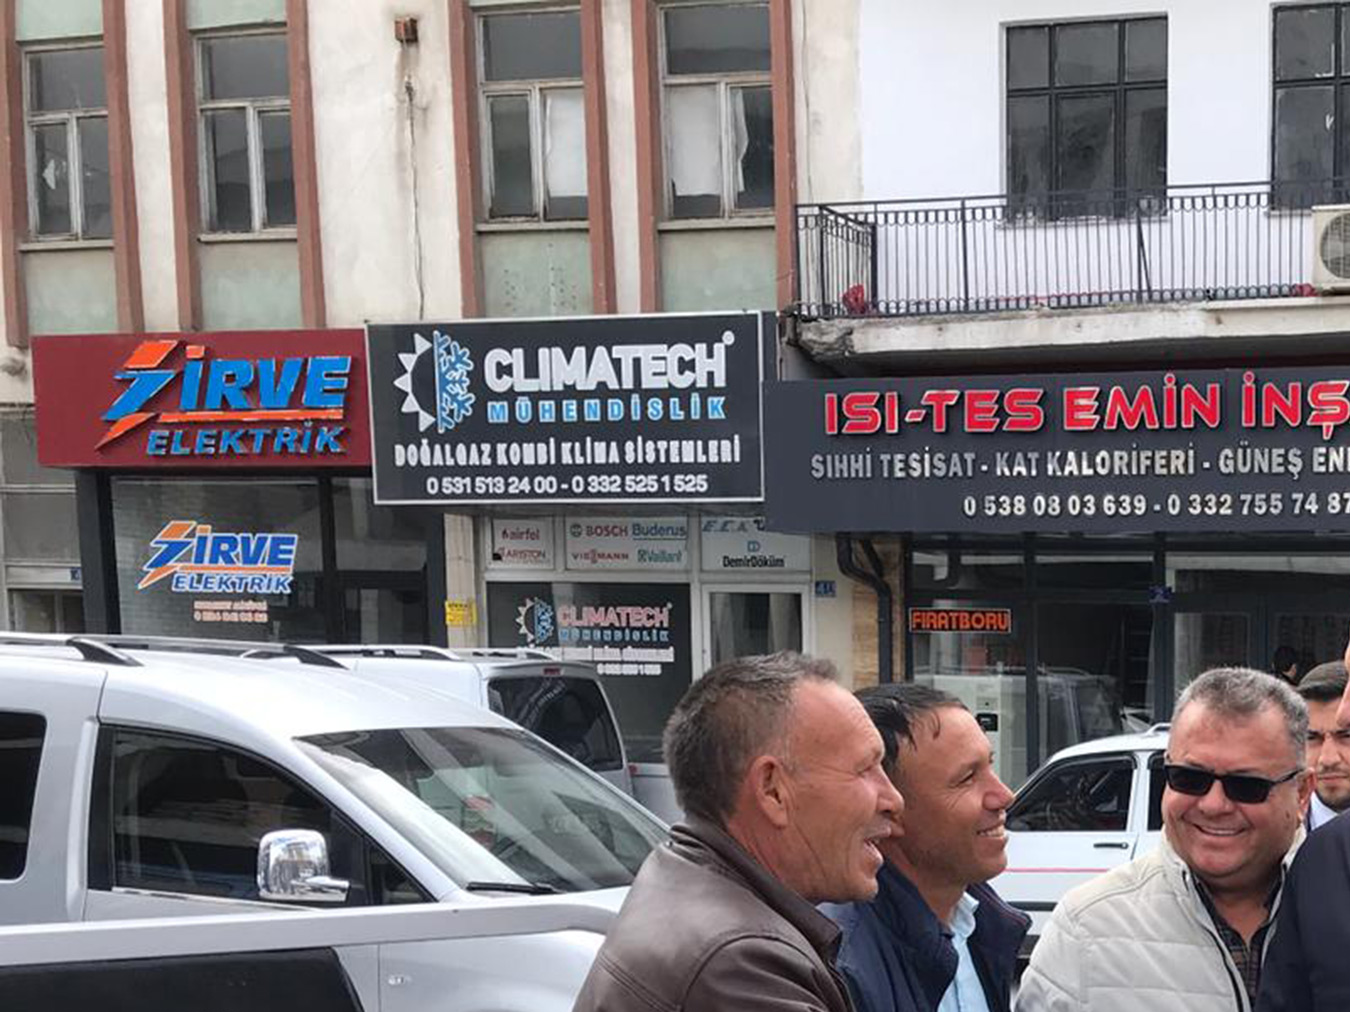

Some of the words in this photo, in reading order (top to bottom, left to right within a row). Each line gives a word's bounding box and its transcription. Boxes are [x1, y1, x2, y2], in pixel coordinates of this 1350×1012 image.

[484, 342, 727, 392] CLIMATECH
[95, 339, 352, 448] ZİRVE
[487, 392, 727, 423] MÜHENDİSLİK
[824, 387, 1046, 435] ISI-TES
[1063, 371, 1221, 432] EMİN
[146, 420, 347, 456] ELEKTRİK
[394, 438, 492, 467] DOĞALGAZ
[496, 437, 557, 466] KOMBİ
[560, 436, 621, 465] KLİMA
[624, 434, 741, 464] SİSTEMLERİ
[810, 447, 872, 479] SIHHİ
[879, 445, 977, 478] TESİSAT
[996, 452, 1040, 477] KAT
[1047, 441, 1195, 477] KALORİFERİ
[1218, 441, 1303, 480] GÜNEŞ
[426, 477, 438, 495] 0
[508, 476, 531, 494] 24
[533, 475, 558, 494] 00
[571, 475, 584, 493] 0
[587, 475, 622, 493] 332
[624, 474, 658, 493] 525
[963, 495, 977, 517] 0
[984, 495, 1027, 516] 538
[1033, 495, 1061, 516] 08
[1067, 495, 1096, 516] 03
[1103, 494, 1148, 515] 639
[1167, 493, 1182, 516] 0
[1187, 493, 1233, 515] 332
[1239, 492, 1284, 515] 755
[1291, 492, 1320, 514] 74
[585, 525, 628, 538] BOSCH
[632, 523, 687, 538] Buderus
[722, 555, 786, 568] DemirDöküm
[558, 604, 669, 628] CLIMATECH
[912, 611, 1008, 630] FIRATBORU
